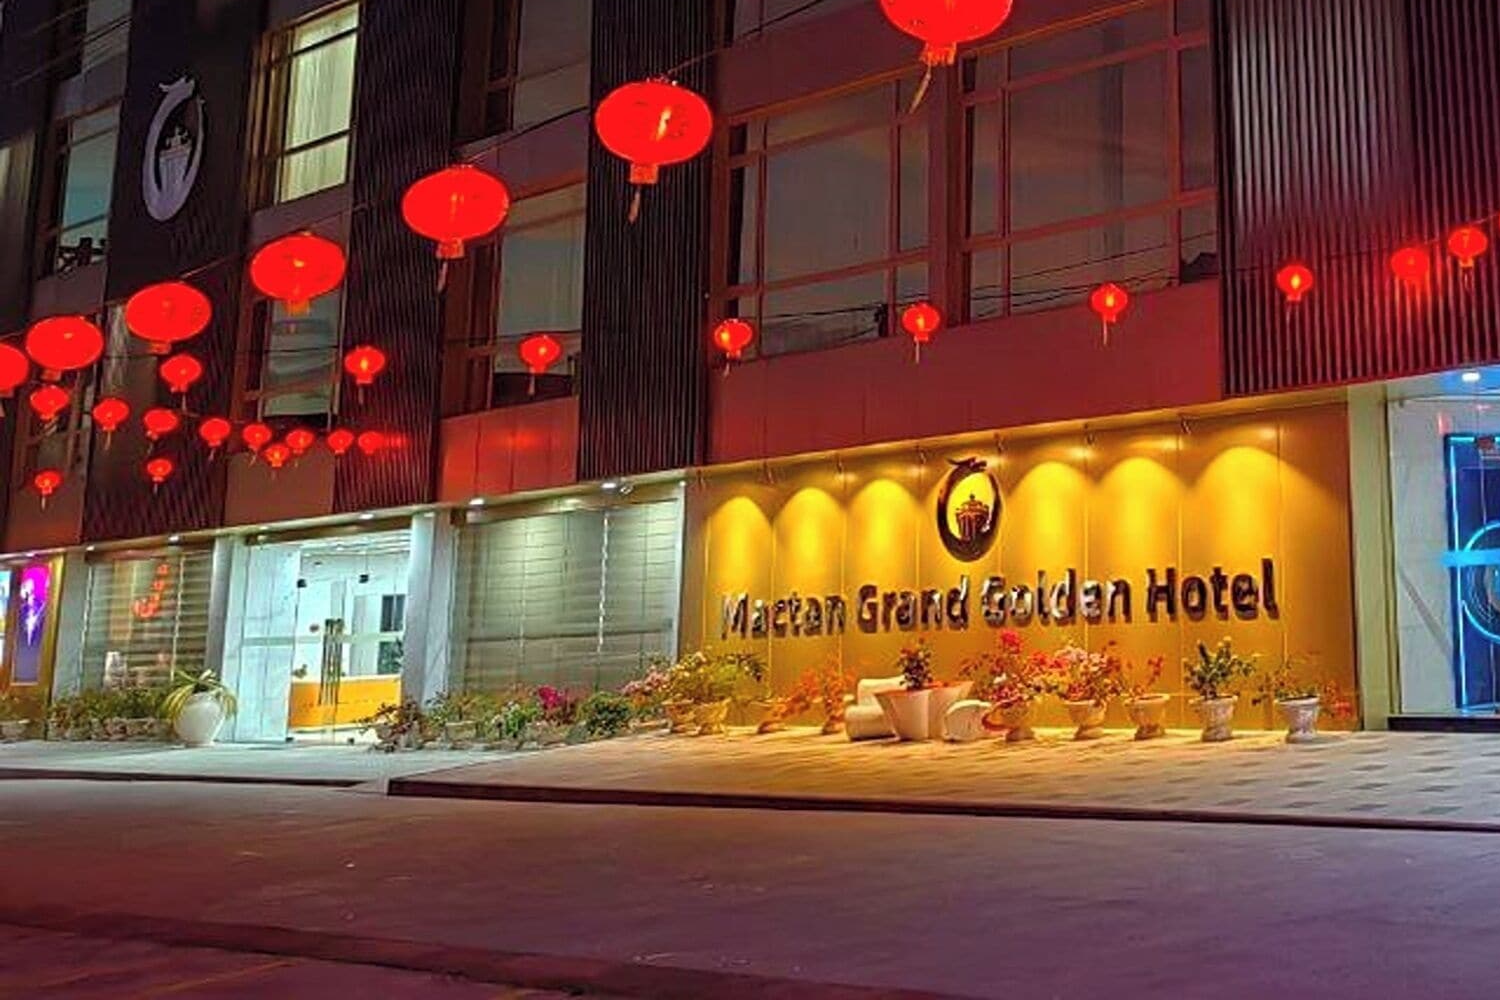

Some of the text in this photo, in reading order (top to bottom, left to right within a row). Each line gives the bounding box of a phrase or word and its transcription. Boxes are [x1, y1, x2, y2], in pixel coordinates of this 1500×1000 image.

[720, 557, 1279, 639] Mactan Grand Golden Hotel
